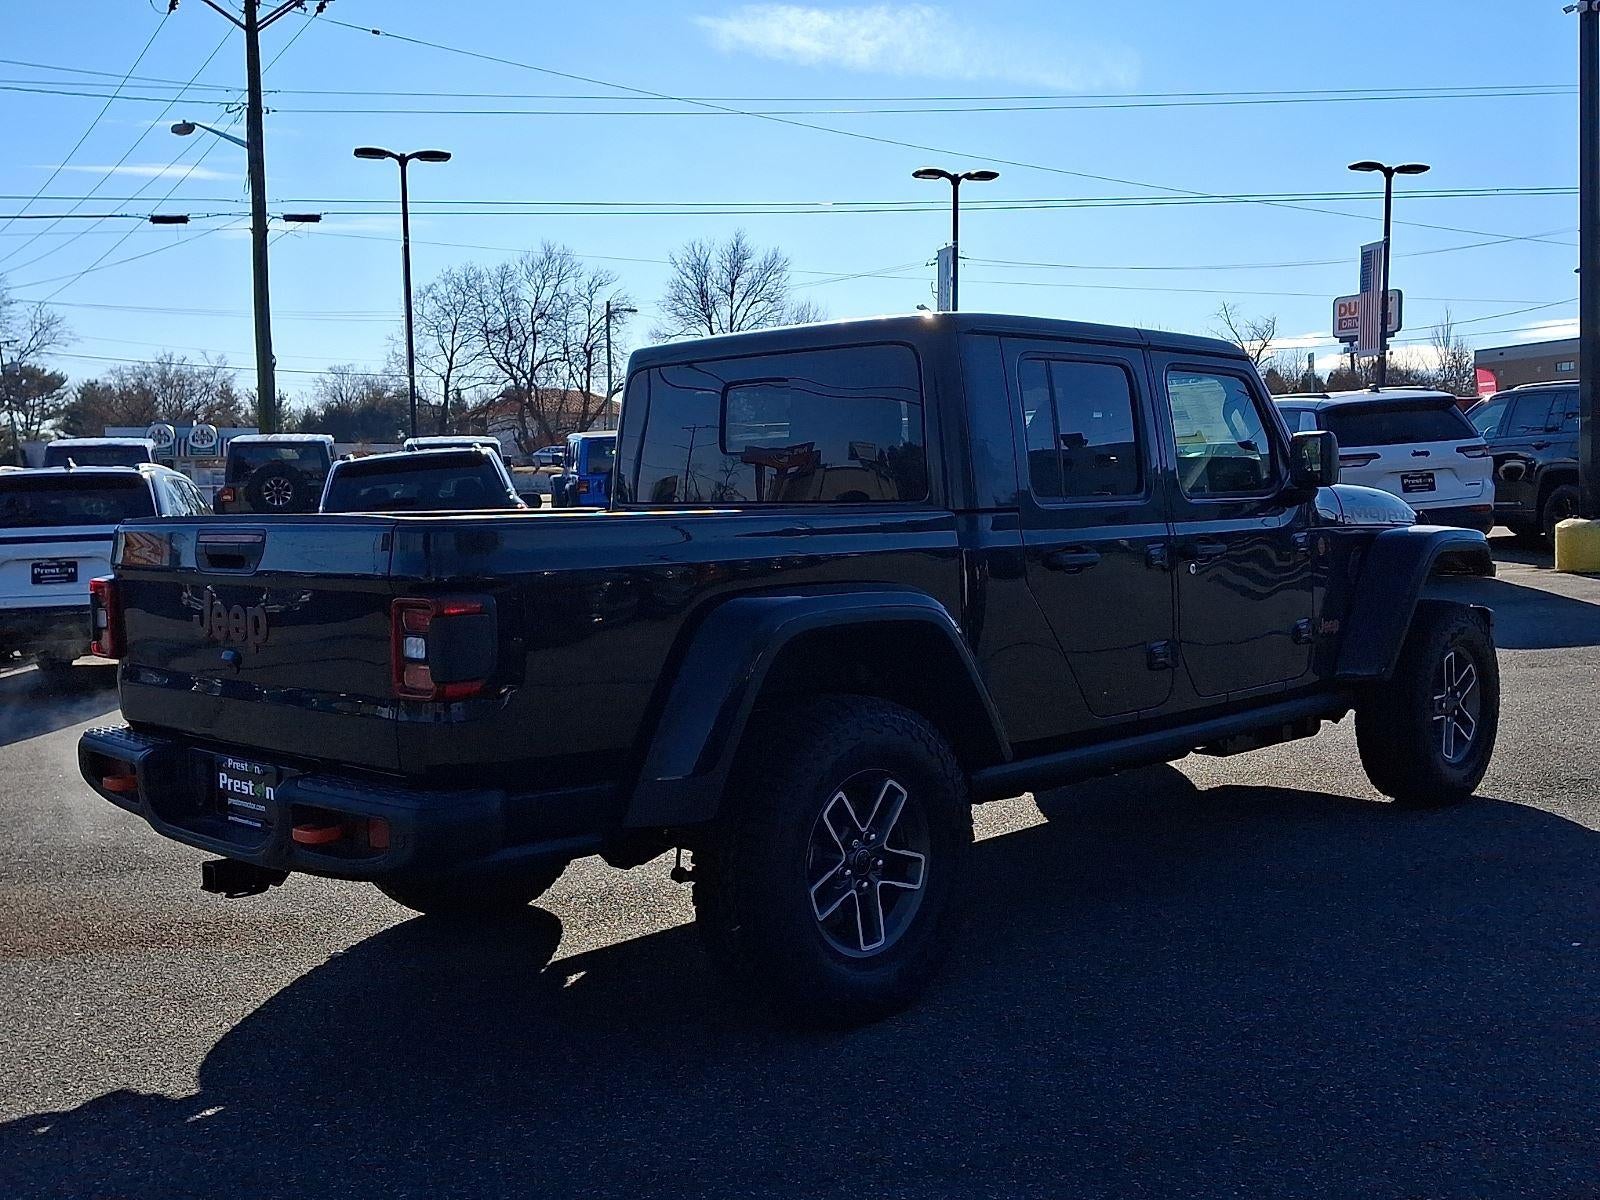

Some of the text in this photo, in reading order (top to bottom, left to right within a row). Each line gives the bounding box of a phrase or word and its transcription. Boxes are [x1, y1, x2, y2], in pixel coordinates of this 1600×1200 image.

[1342, 321, 1359, 329] DRIV
[192, 590, 267, 656] Jeep
[219, 772, 275, 801] Preston
